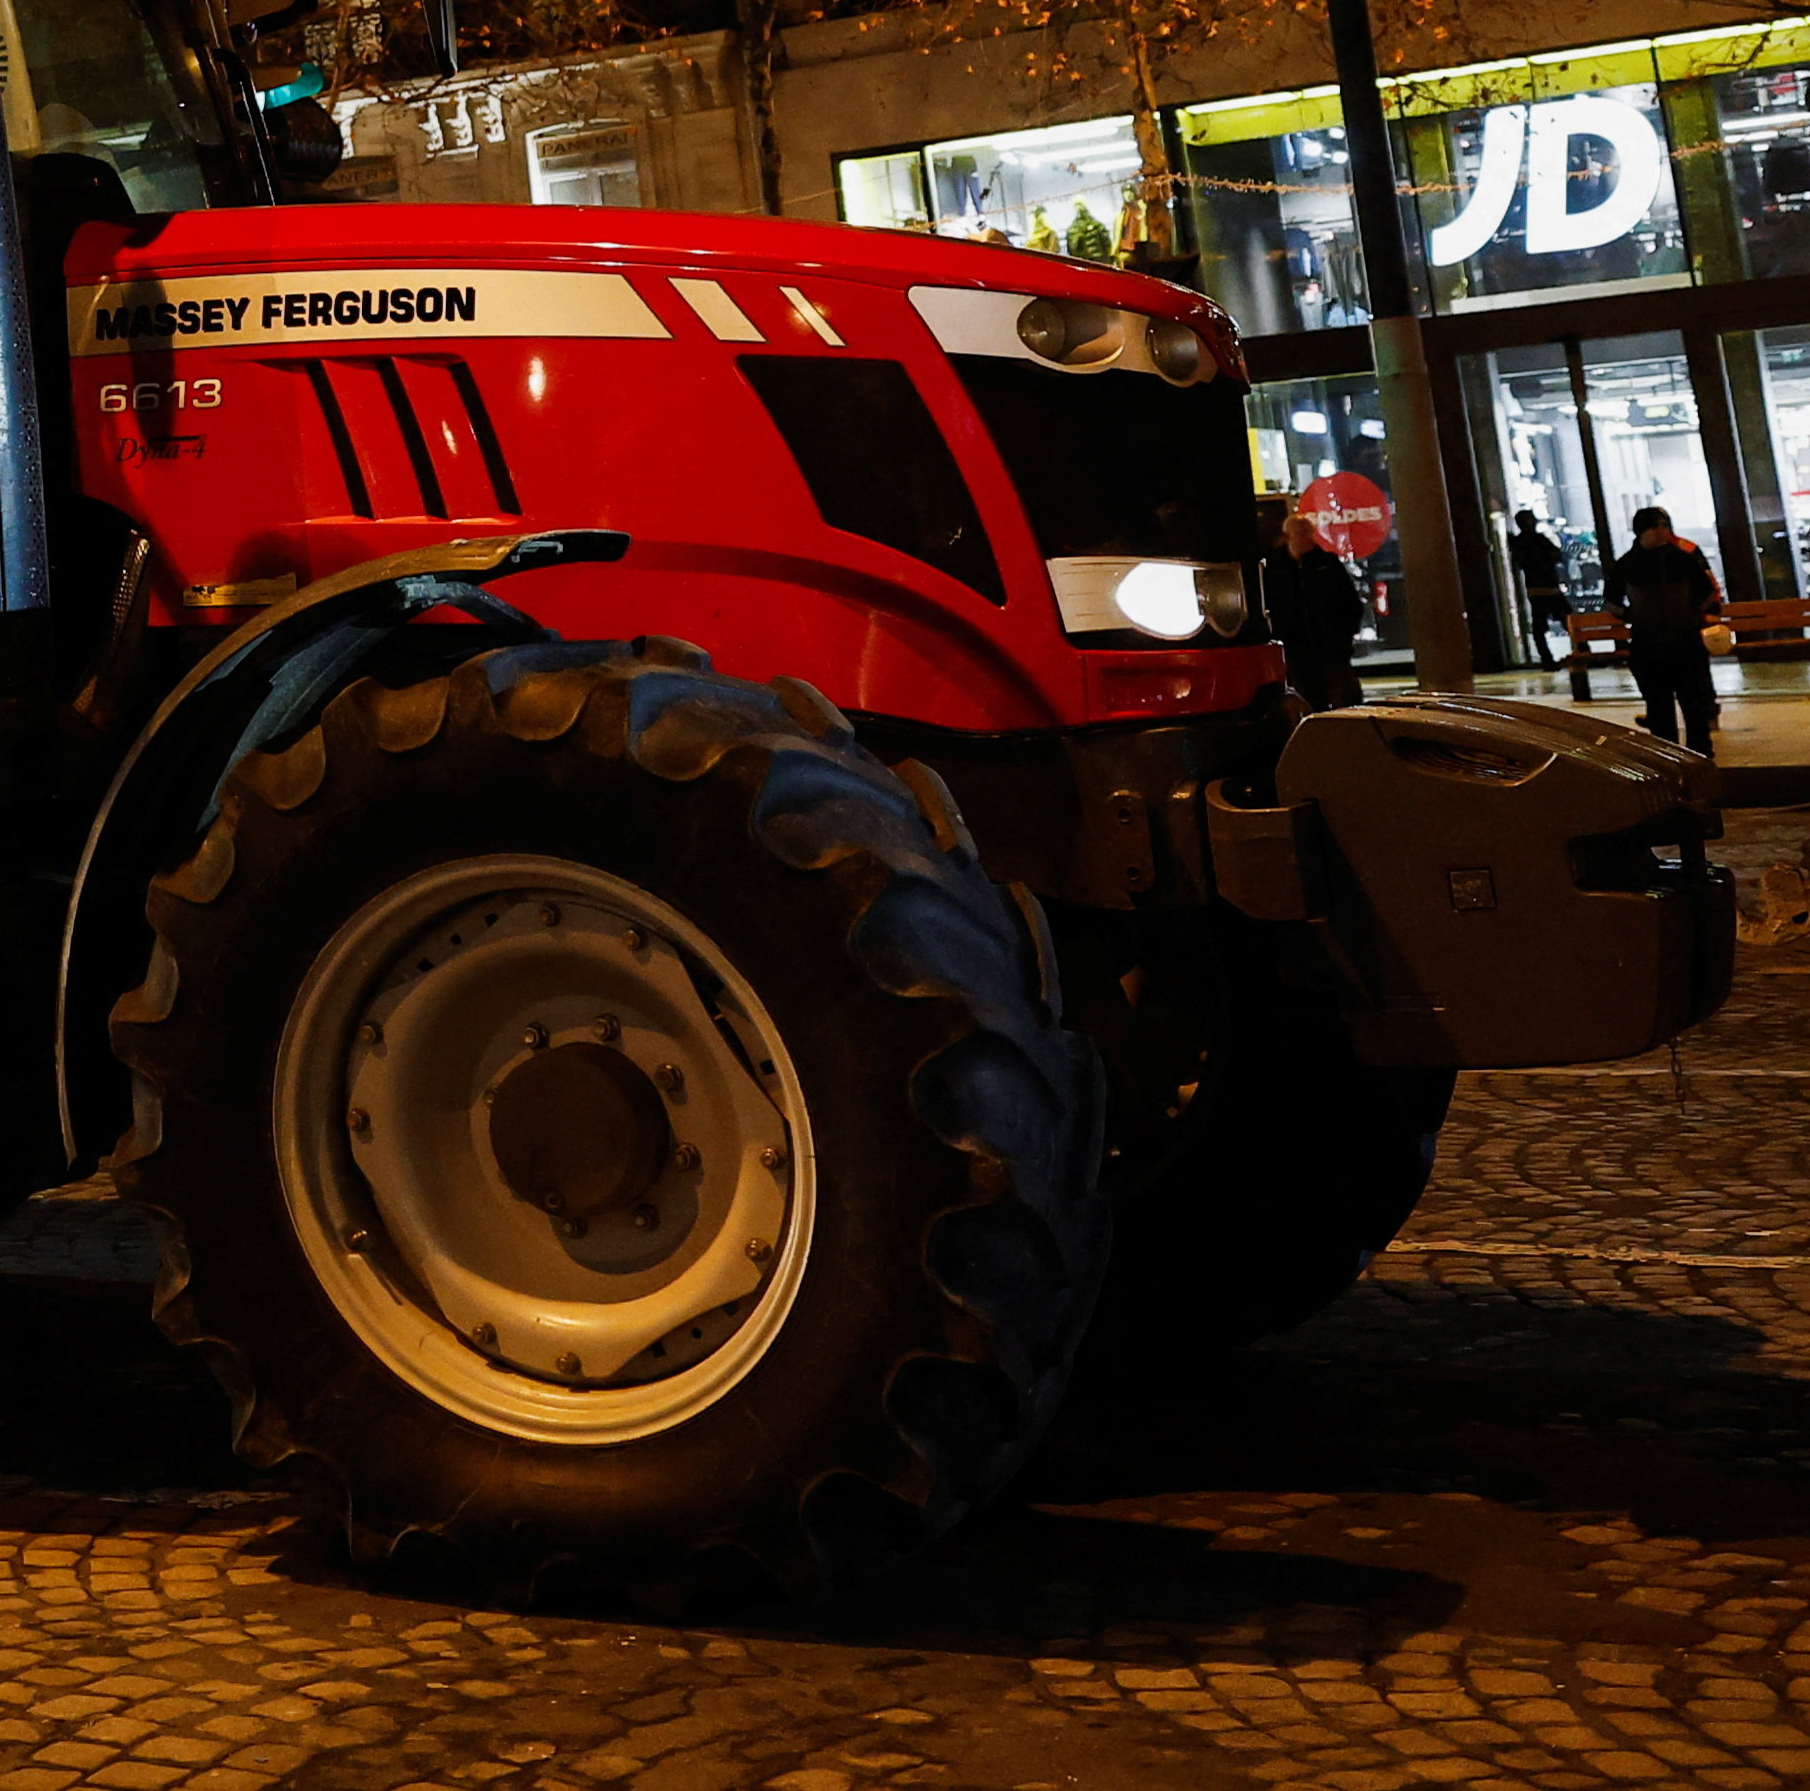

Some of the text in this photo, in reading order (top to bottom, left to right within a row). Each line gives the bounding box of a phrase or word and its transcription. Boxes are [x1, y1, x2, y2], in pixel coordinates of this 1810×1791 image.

[1430, 95, 1661, 267] JD
[95, 287, 476, 341] MASSEY FERGUSON
[99, 378, 223, 414] 6613
